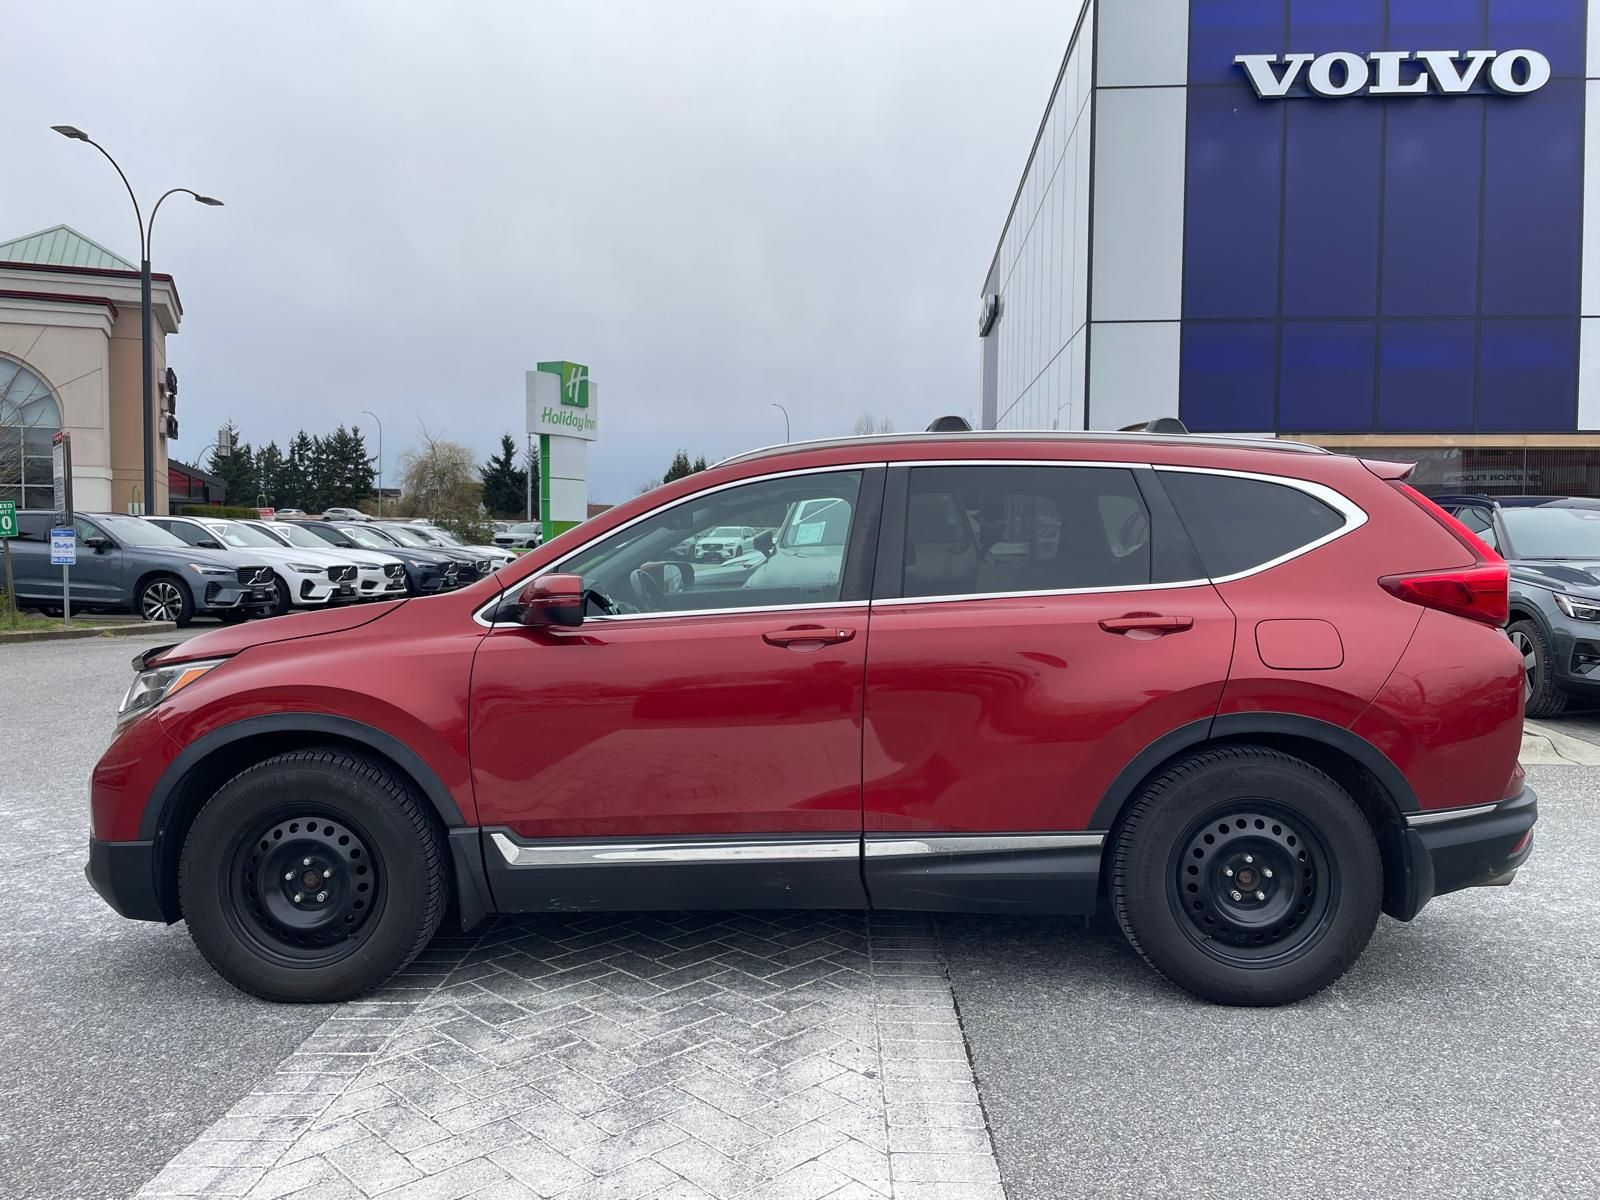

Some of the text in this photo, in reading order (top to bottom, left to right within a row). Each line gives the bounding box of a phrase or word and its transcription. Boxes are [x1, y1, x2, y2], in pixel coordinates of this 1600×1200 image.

[1233, 49, 1551, 98] VOLVO
[542, 406, 597, 431] Holiday Inn
